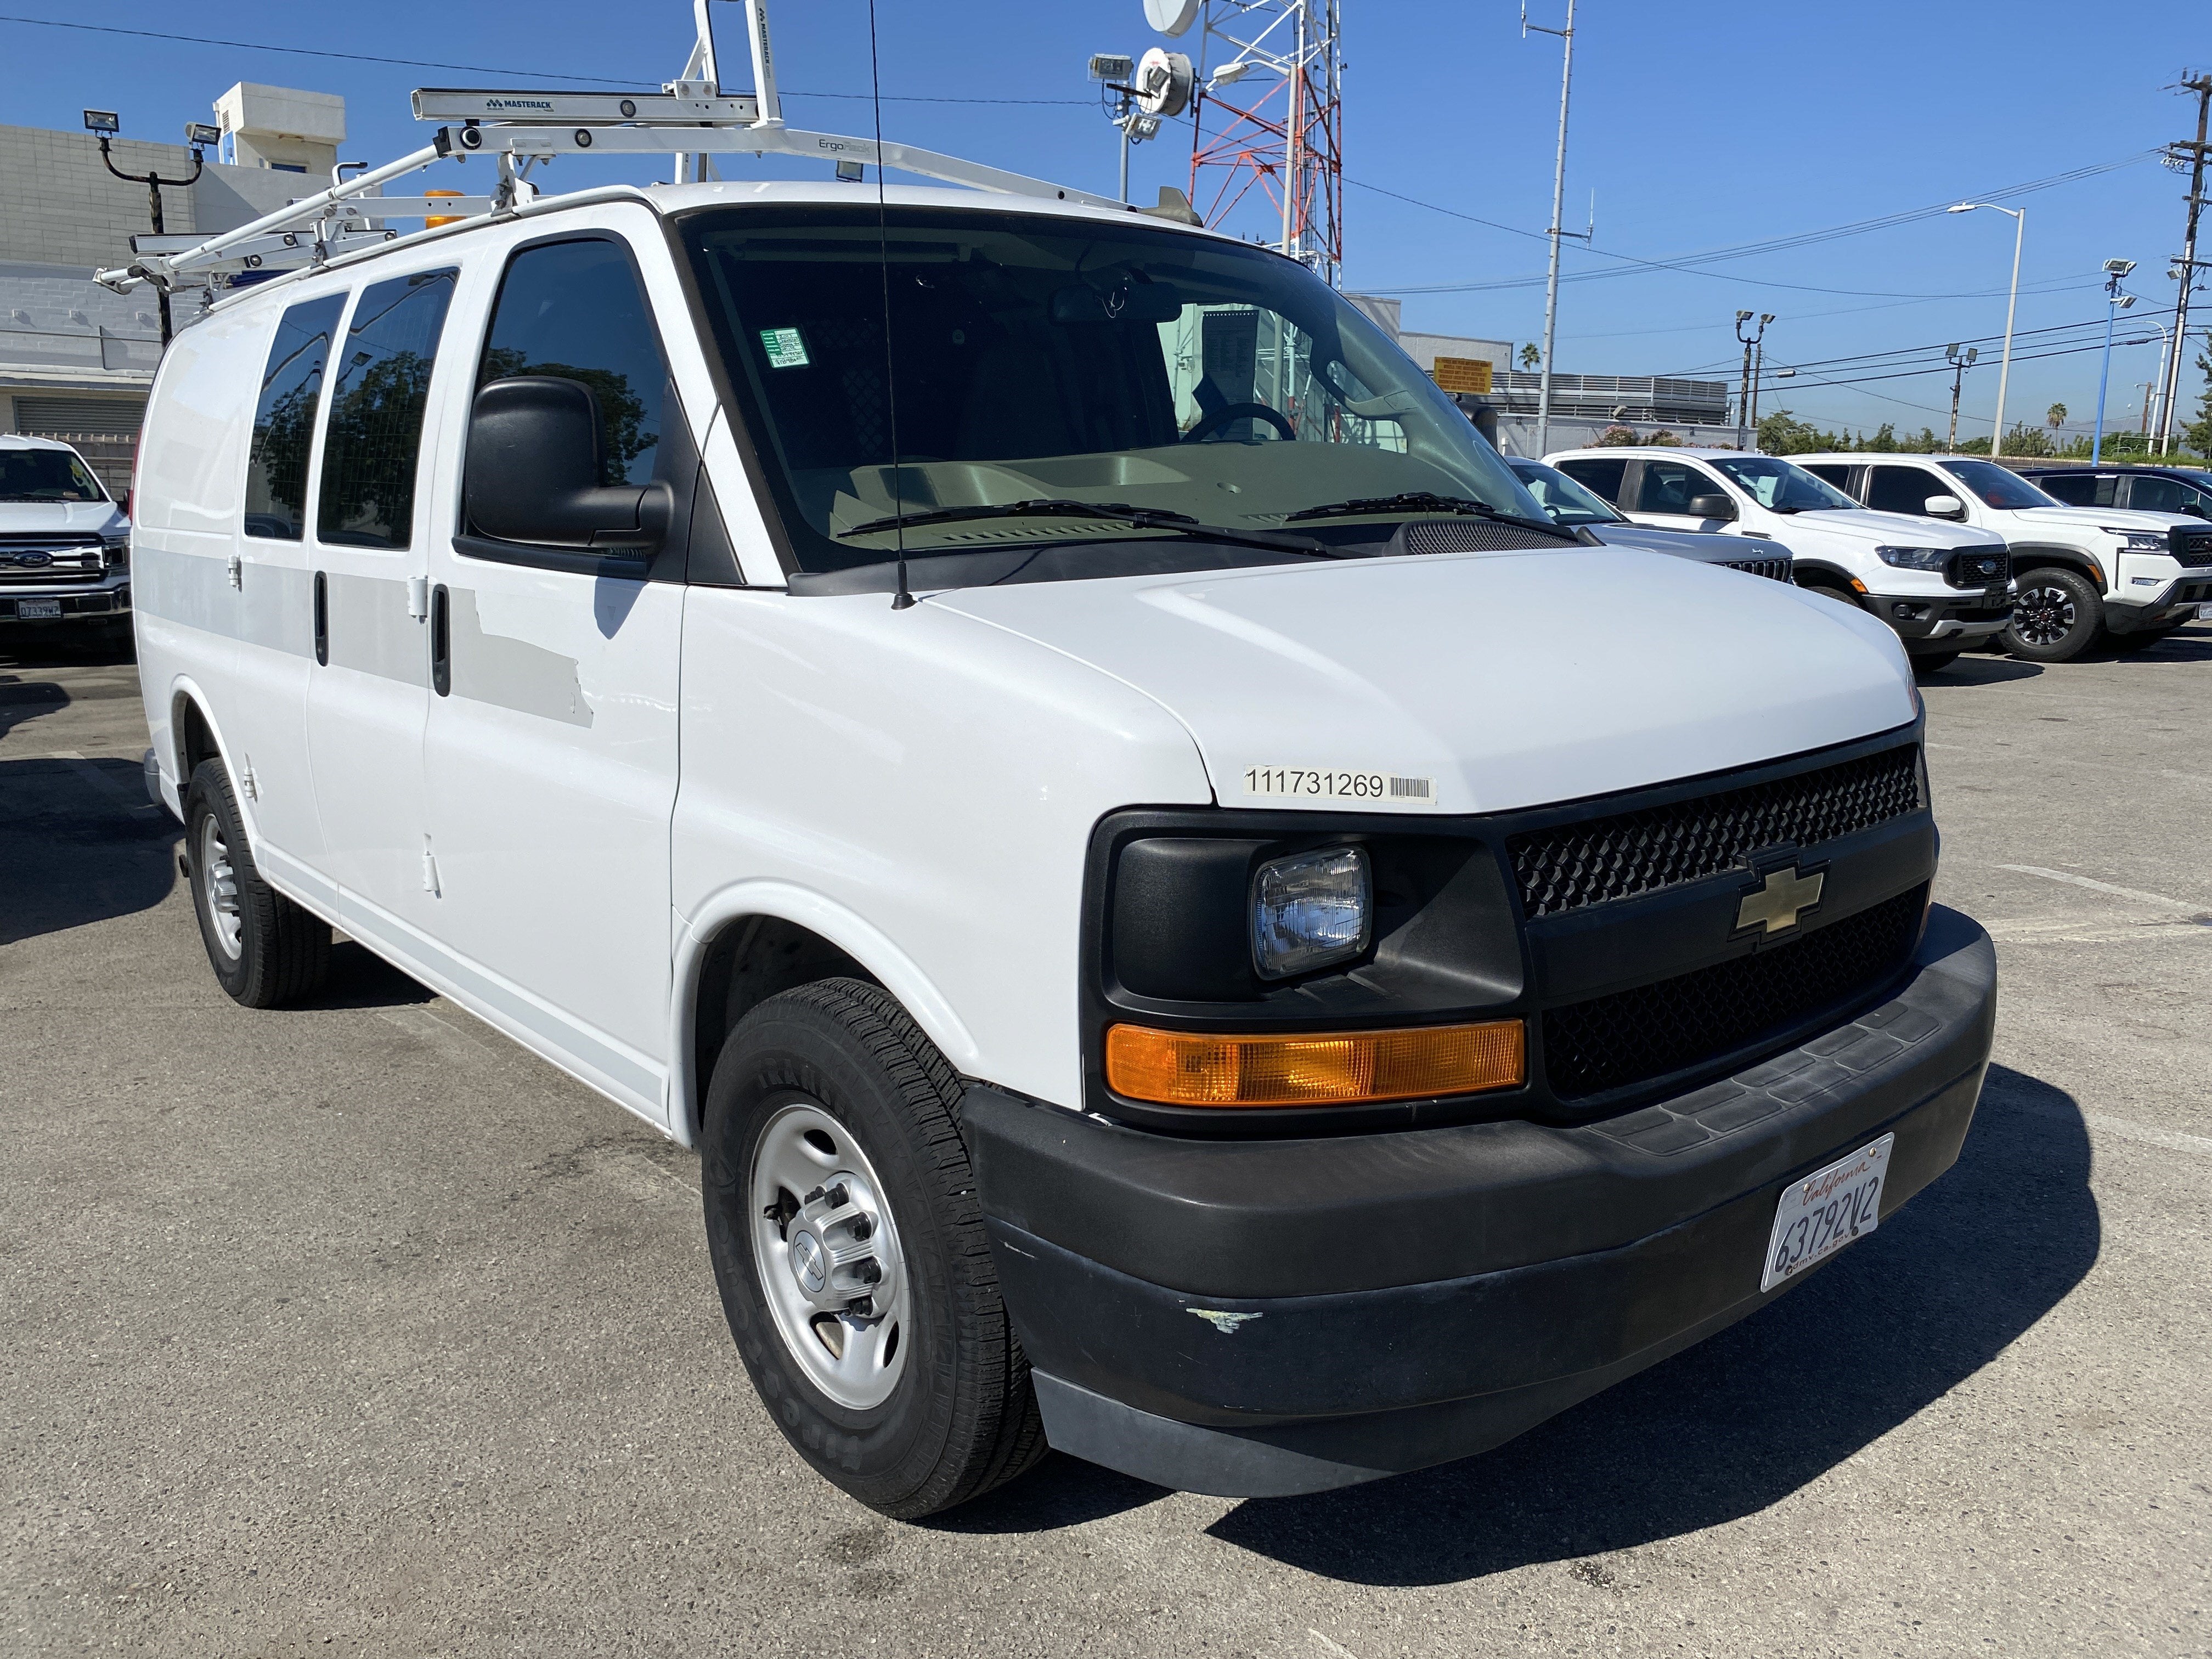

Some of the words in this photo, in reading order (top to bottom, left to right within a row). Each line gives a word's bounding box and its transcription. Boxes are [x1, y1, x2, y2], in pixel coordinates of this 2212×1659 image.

[504, 100, 552, 109] MASTERACK
[1247, 768, 1384, 798] 111731269
[1803, 1160, 1871, 1206] California
[1775, 1176, 1879, 1273] 63792V2
[1792, 1232, 1849, 1270] dmv.ca.gov
